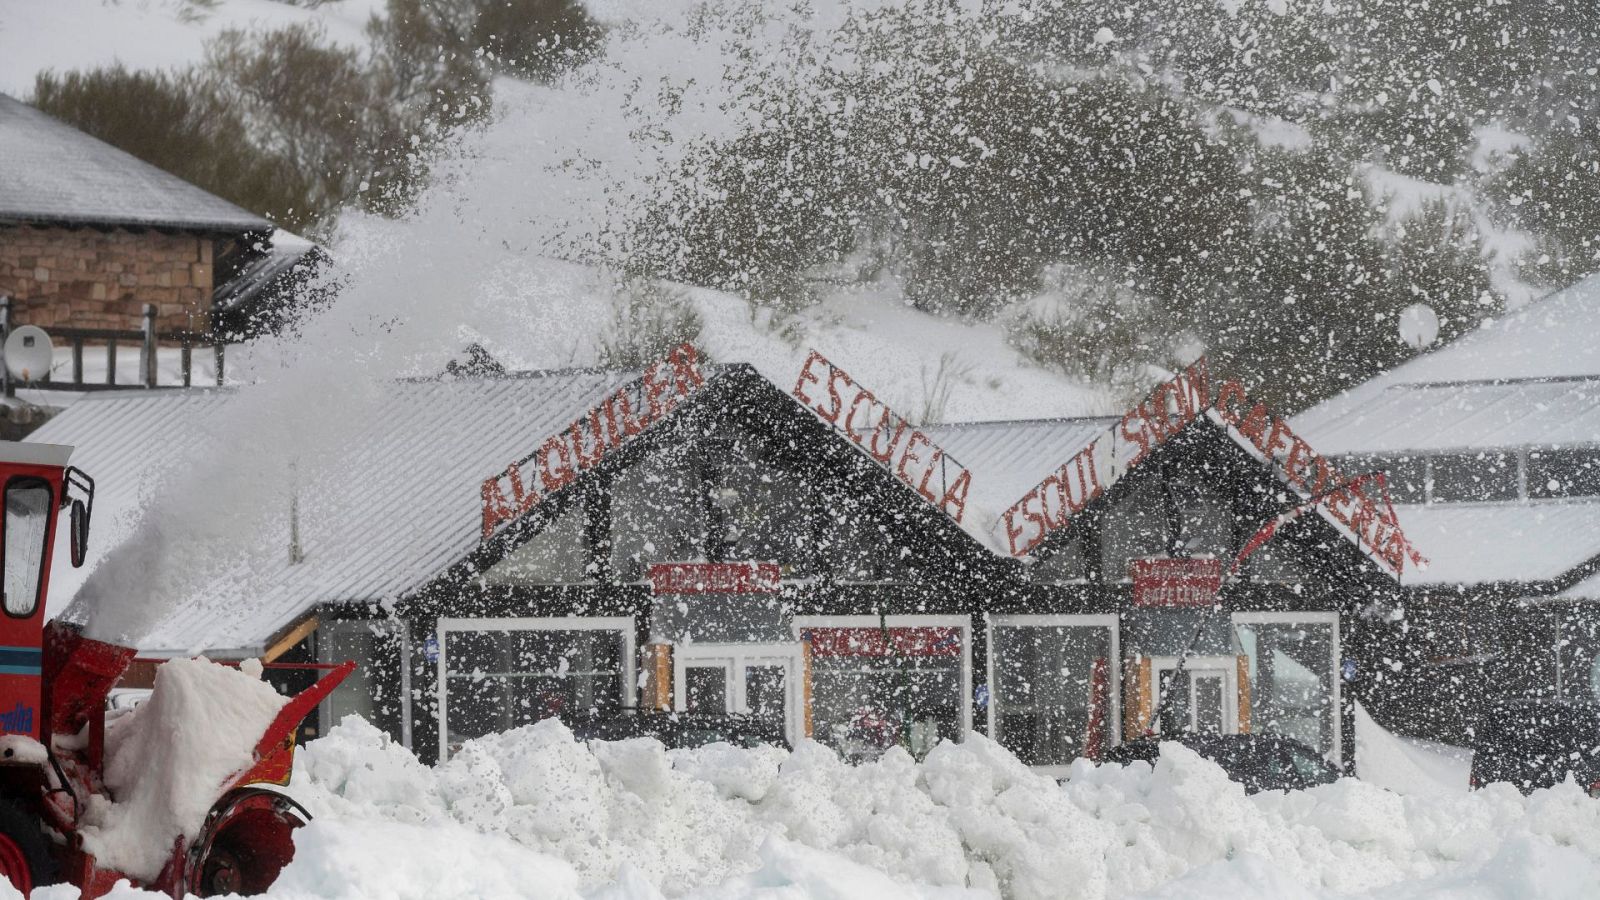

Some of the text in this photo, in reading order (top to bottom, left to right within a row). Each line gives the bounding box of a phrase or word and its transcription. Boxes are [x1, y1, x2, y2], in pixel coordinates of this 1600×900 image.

[481, 342, 703, 538] ALQUILER
[792, 350, 972, 524] ESCUELA
[1004, 356, 1209, 557] ESQUI SNOW
